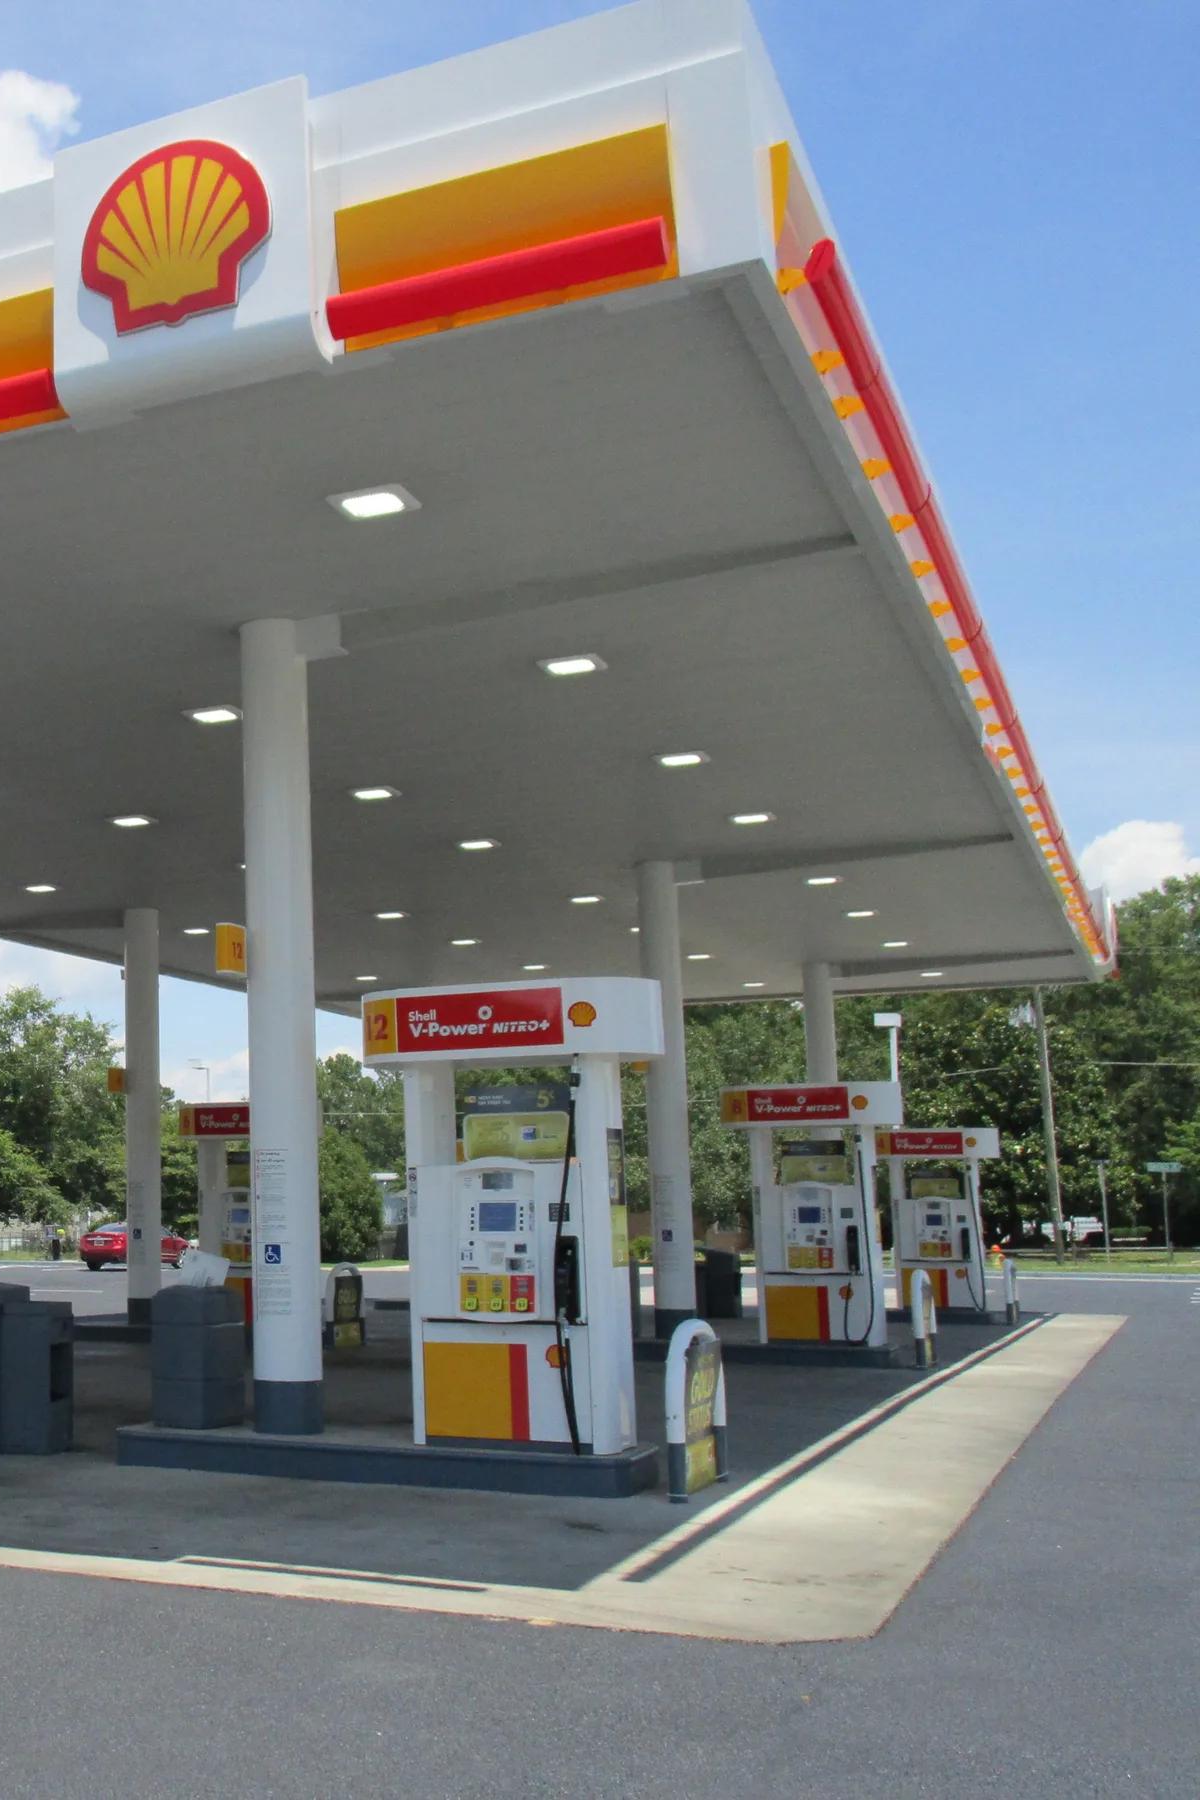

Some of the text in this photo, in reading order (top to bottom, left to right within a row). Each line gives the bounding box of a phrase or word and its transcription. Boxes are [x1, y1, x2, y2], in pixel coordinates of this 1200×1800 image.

[408, 1009, 437, 1022] Shell
[365, 1013, 389, 1041] 12
[409, 1022, 486, 1038] V-Power
[755, 1104, 802, 1113] V-Power
